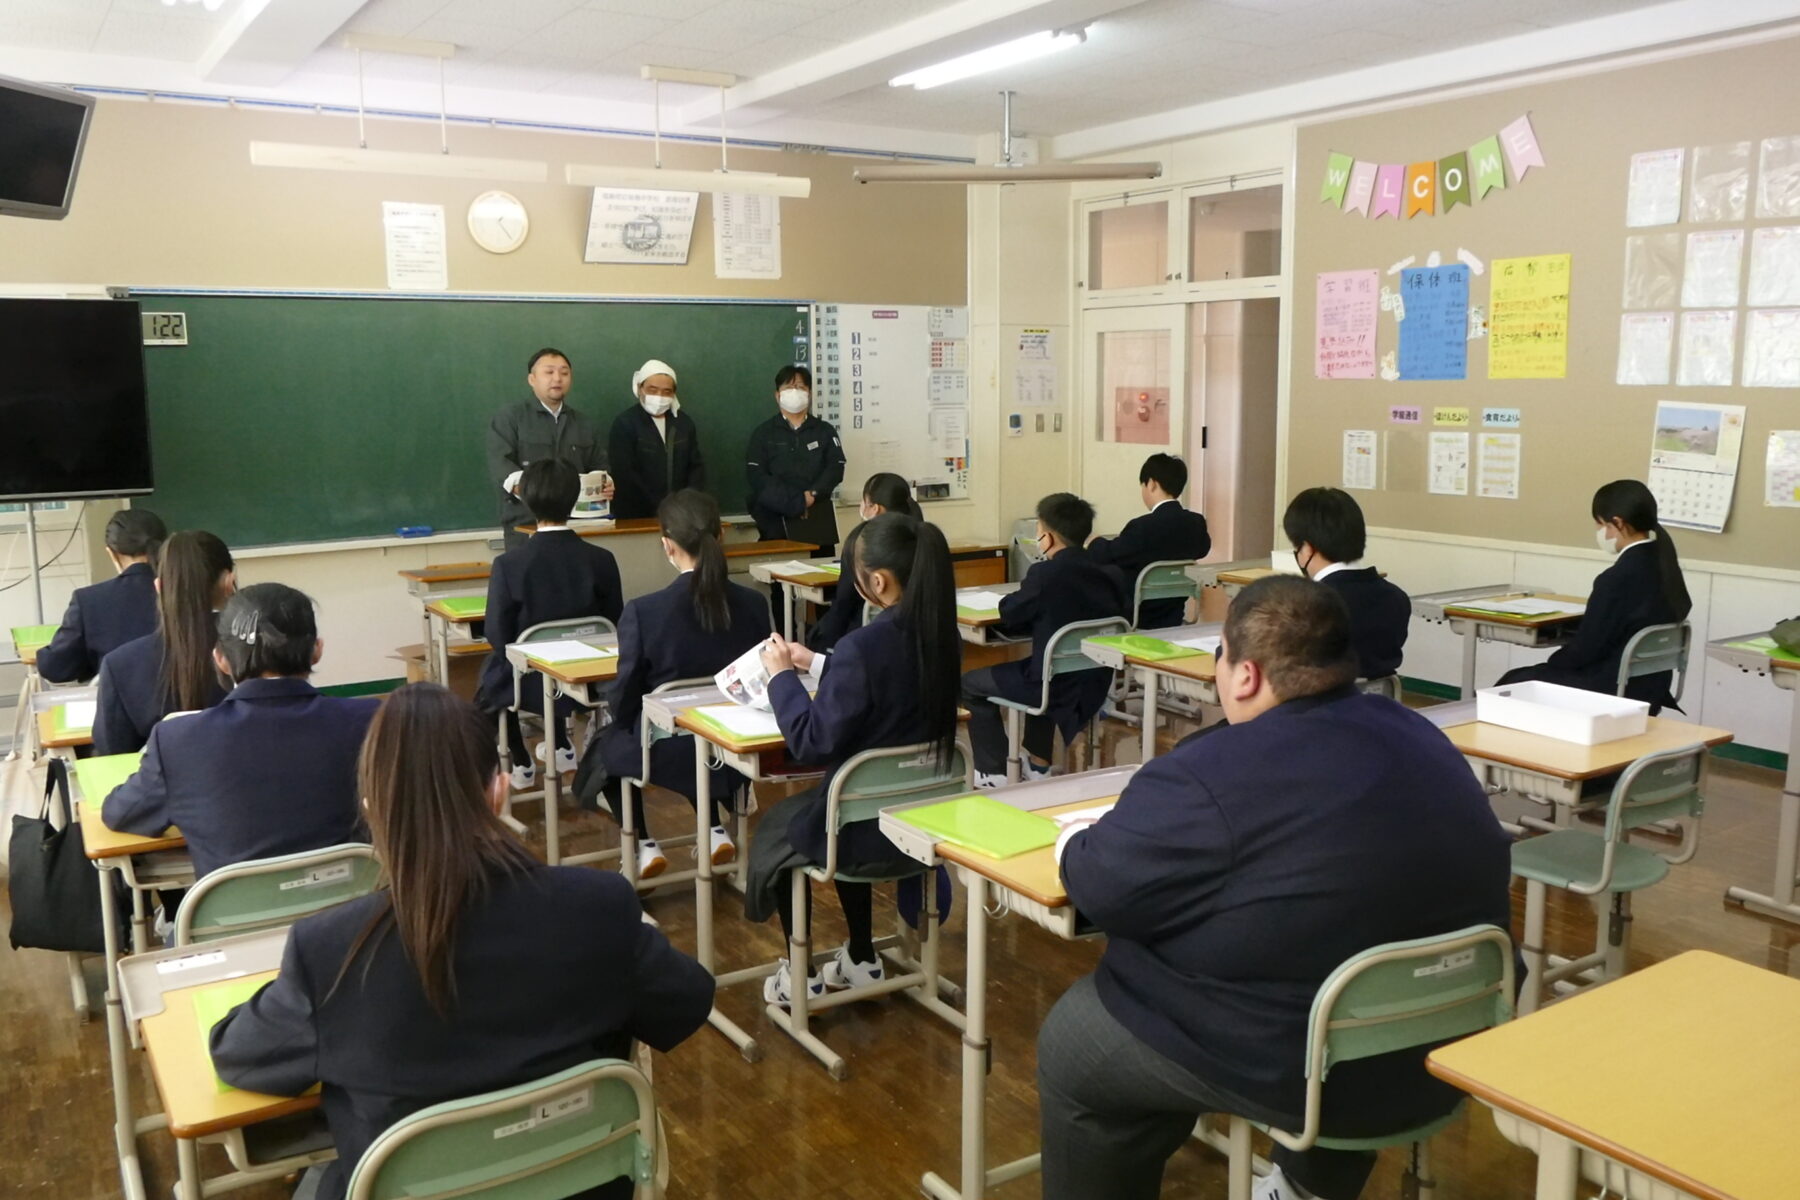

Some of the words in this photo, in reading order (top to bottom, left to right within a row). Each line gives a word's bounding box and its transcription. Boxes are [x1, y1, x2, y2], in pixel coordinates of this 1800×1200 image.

[1328, 132, 1532, 199] WELCOME
[853, 348, 860, 360] 2
[853, 364, 861, 376] 3
[854, 381, 862, 394] 4
[854, 398, 862, 411] 5
[854, 415, 862, 429] 6
[313, 873, 320, 881] L
[541, 1107, 550, 1119] L
